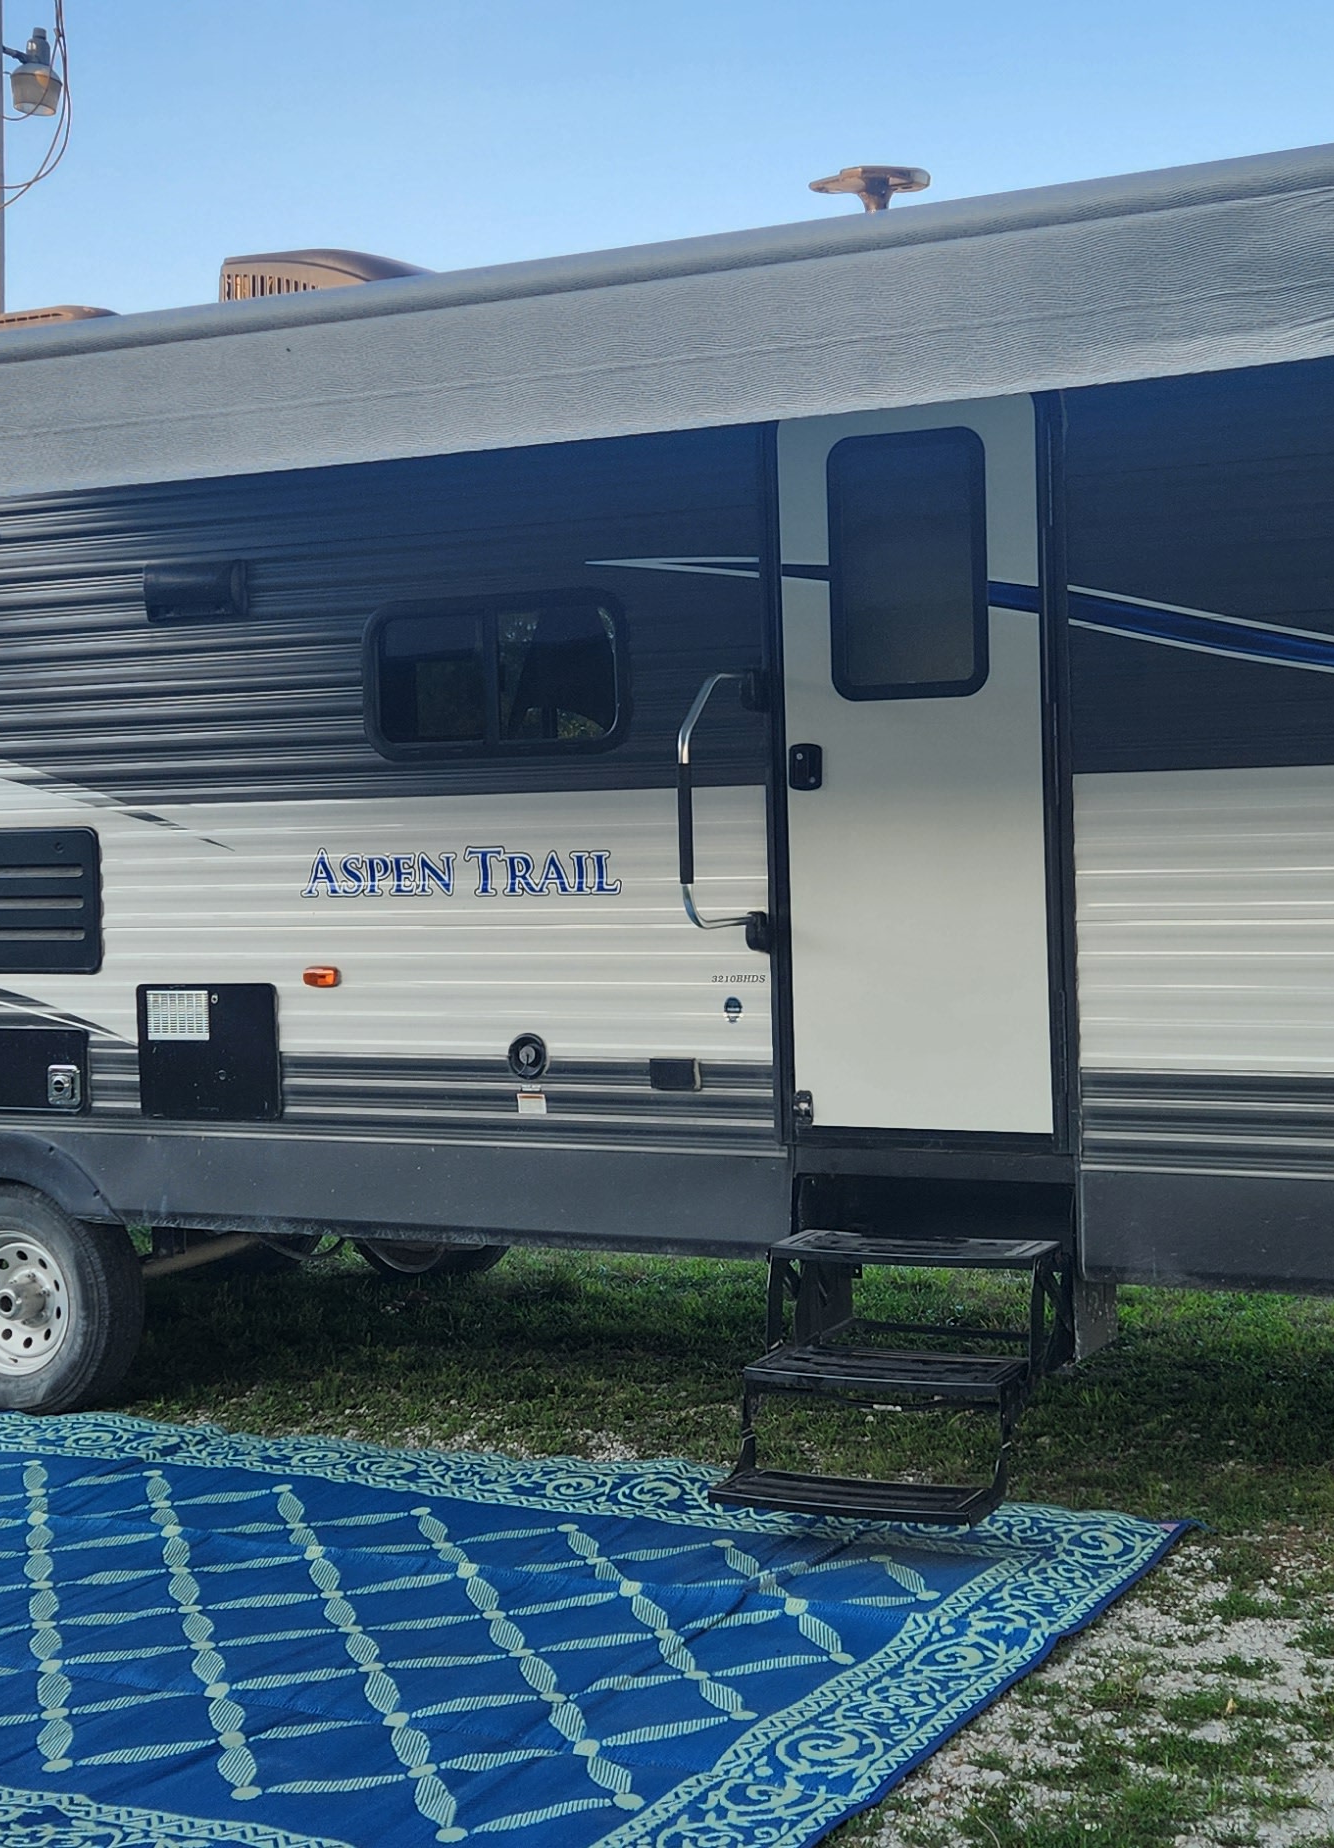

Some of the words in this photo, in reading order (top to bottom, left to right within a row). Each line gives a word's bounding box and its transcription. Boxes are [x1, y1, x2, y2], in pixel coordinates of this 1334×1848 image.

[301, 848, 457, 898] ASPEN
[464, 846, 622, 897] TRAIL
[711, 974, 766, 984] 3210BHDS
